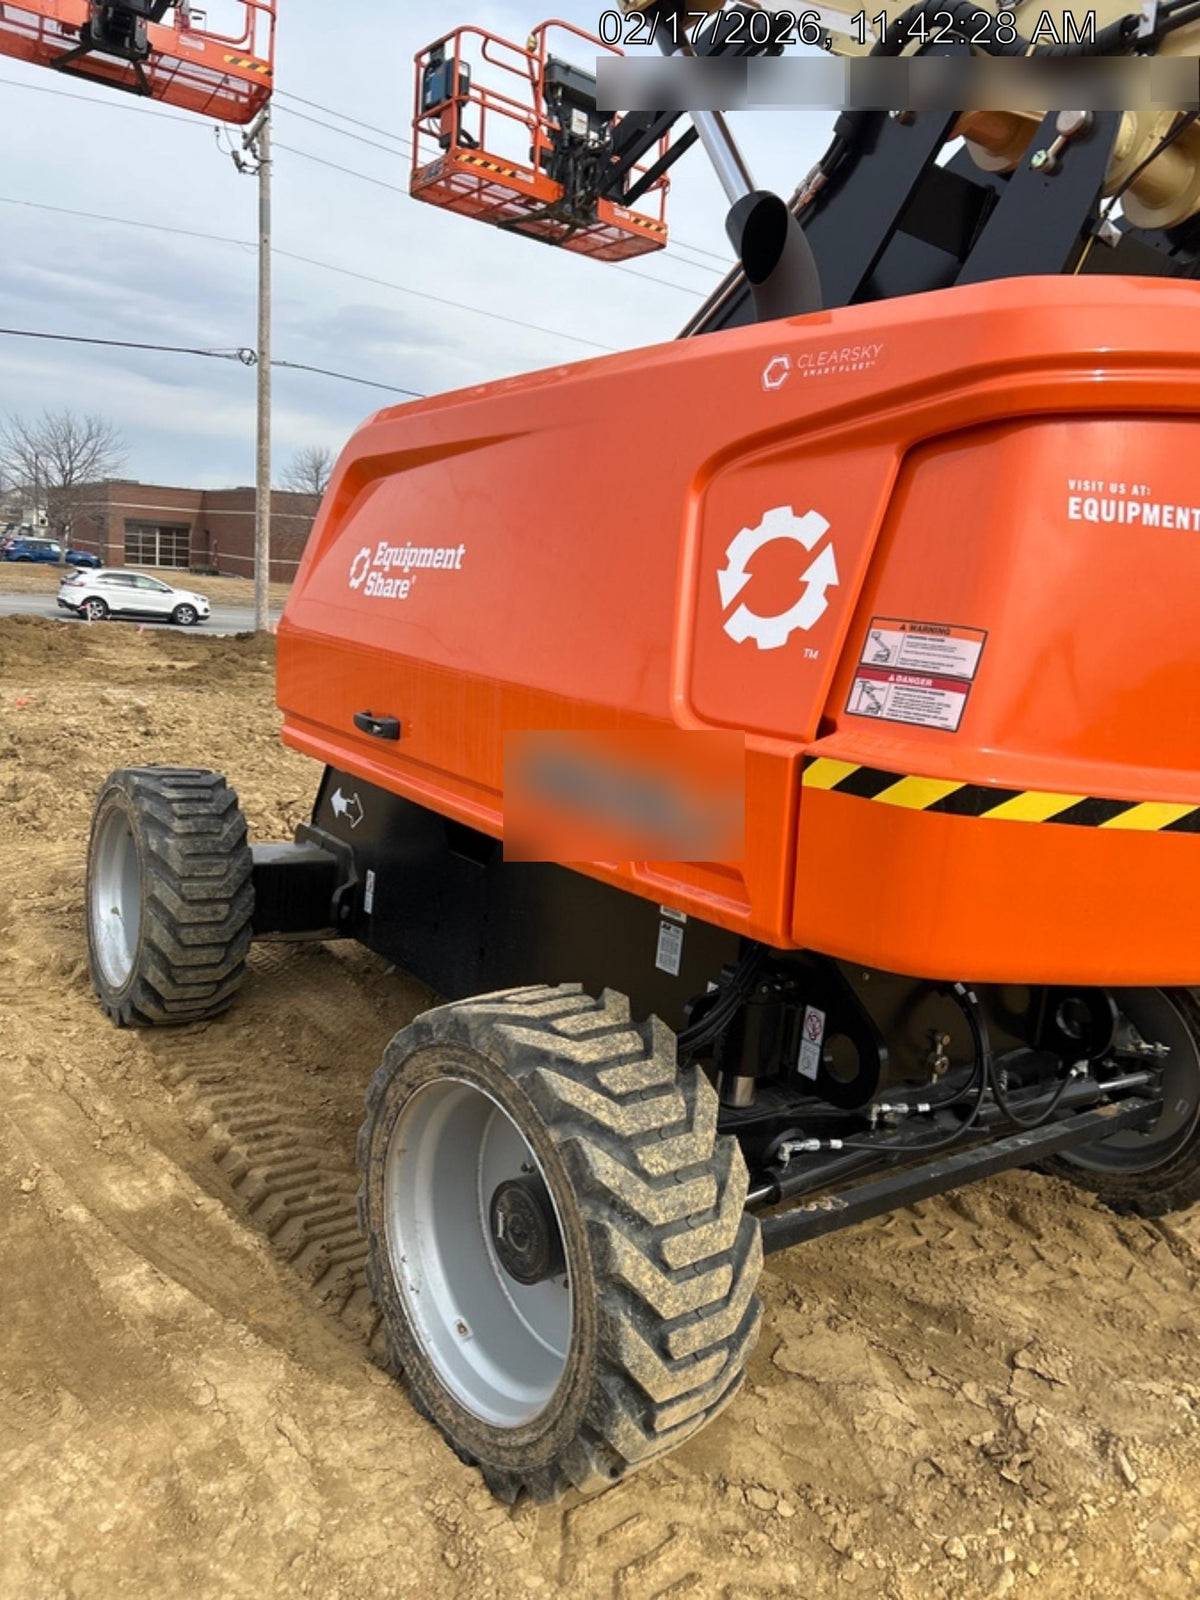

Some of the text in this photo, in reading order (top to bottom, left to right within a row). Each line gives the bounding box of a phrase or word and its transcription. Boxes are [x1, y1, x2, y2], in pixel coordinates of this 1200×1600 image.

[798, 344, 883, 369] CLEARSKY
[1067, 479, 1151, 497] VISIT US AT:
[1067, 496, 1200, 532] EQUIPMENT
[372, 541, 466, 573] Equipment
[908, 624, 951, 636] WARNING
[803, 648, 819, 660] TM
[896, 675, 933, 687] DANGER
